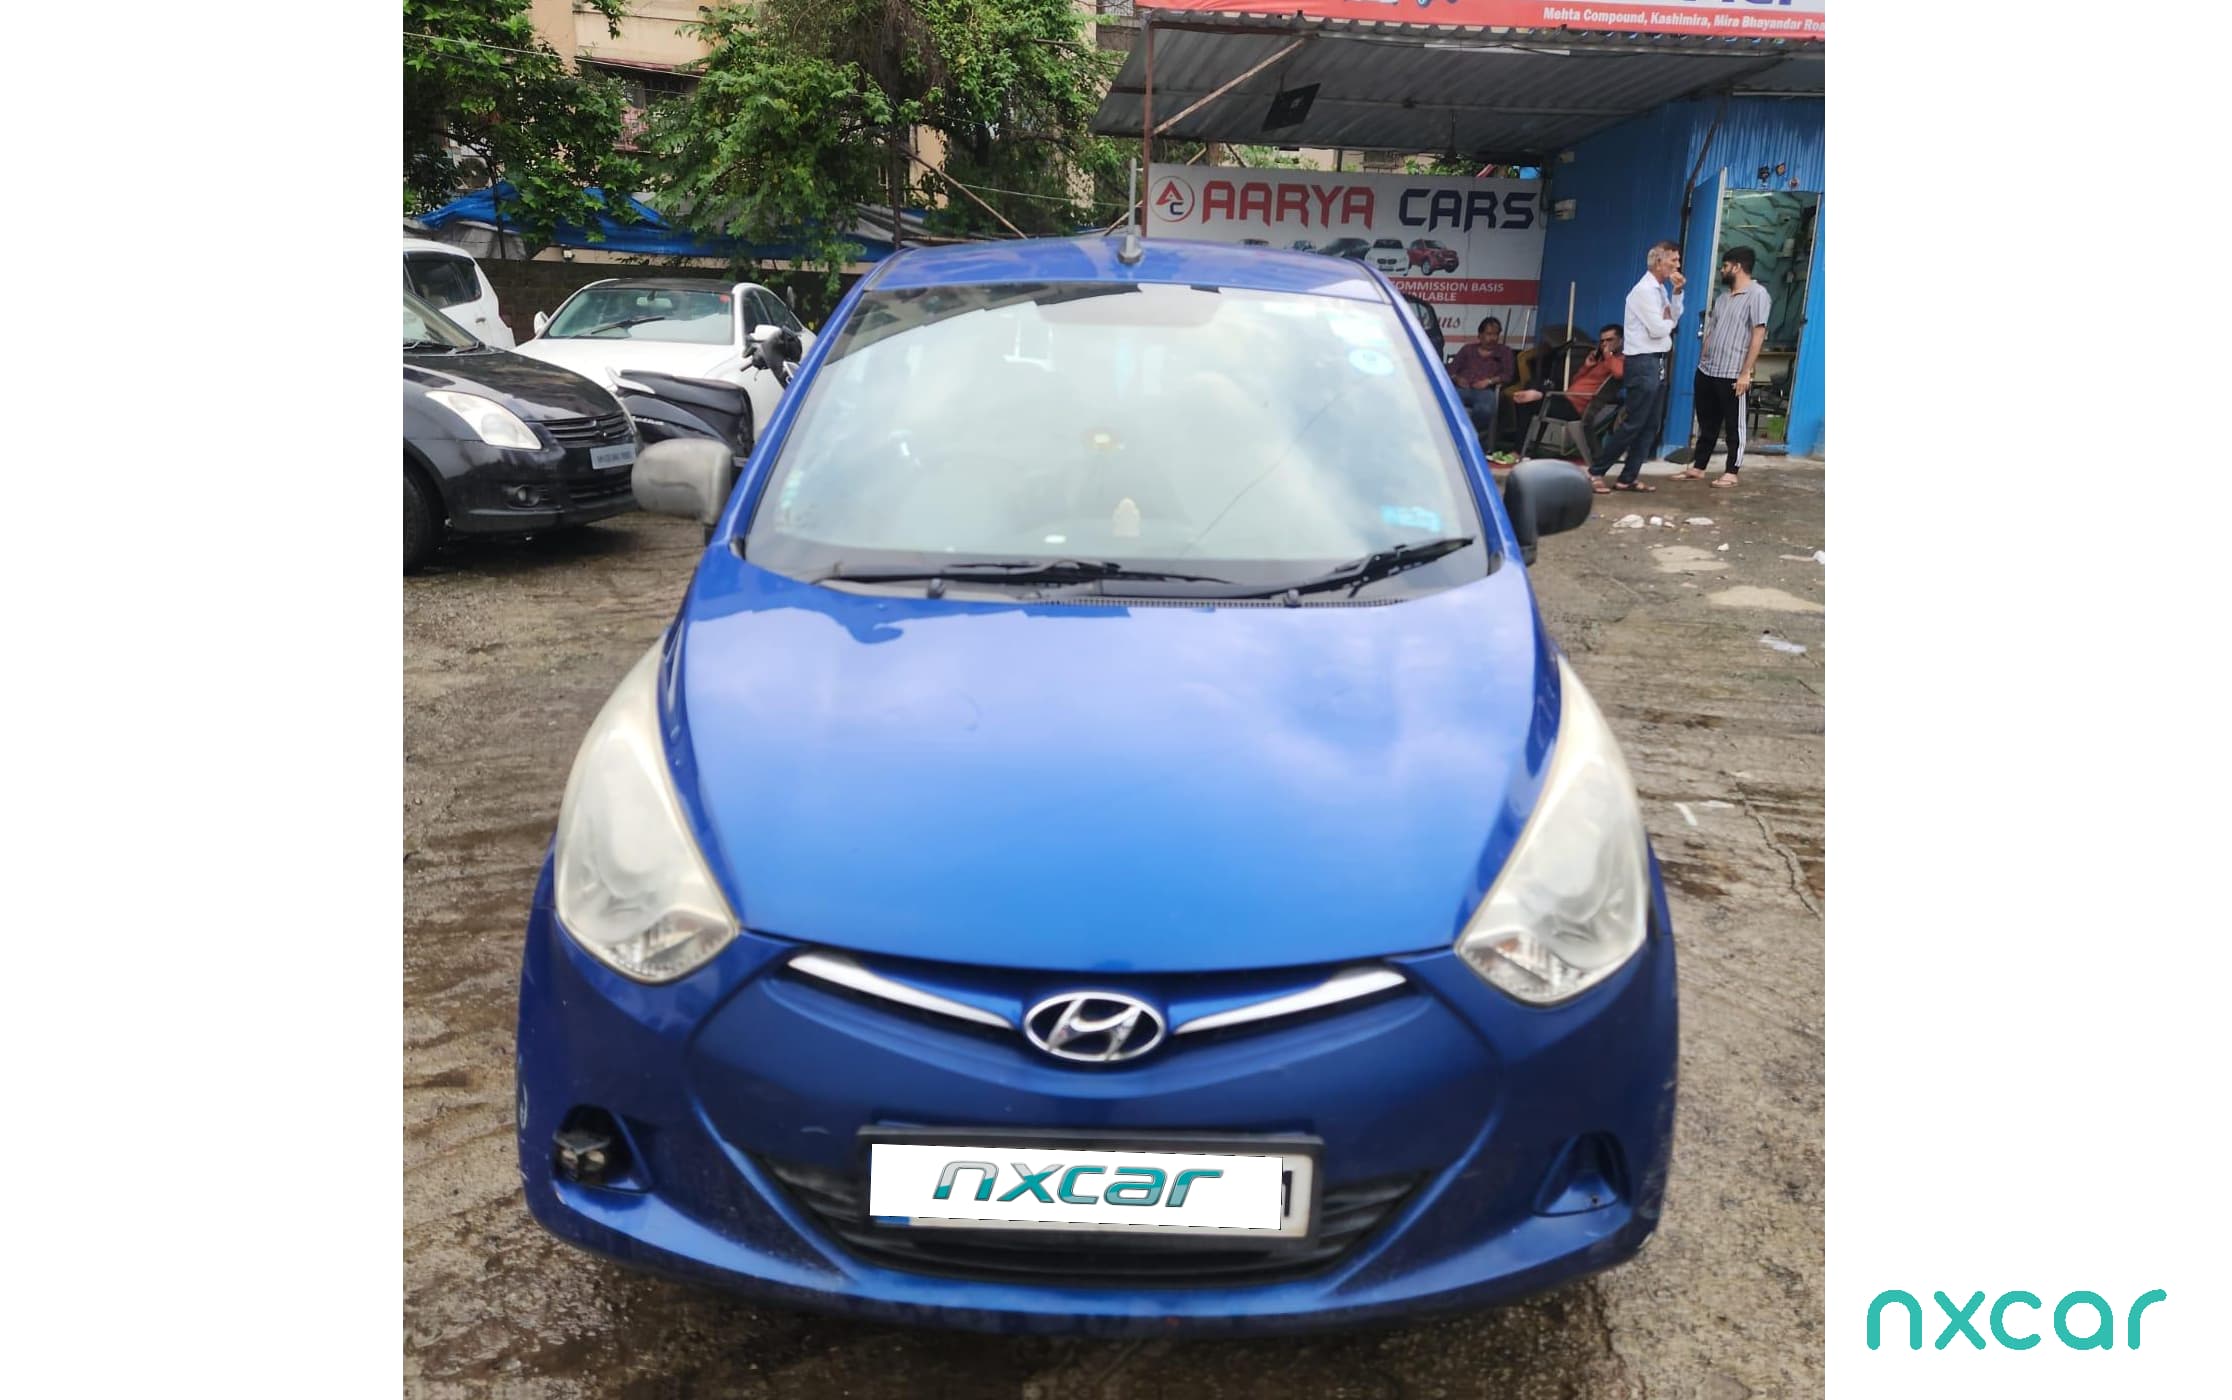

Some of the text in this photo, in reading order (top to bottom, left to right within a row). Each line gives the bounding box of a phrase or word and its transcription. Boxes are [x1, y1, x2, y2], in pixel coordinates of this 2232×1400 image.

[1543, 7, 1825, 32] Mehta Compound, Kashimira, Mira Bhayandar Roa
[1202, 180, 1539, 232] AARYA CARS
[1404, 290, 1457, 302] AILABLE
[1471, 282, 1505, 292] BASIS
